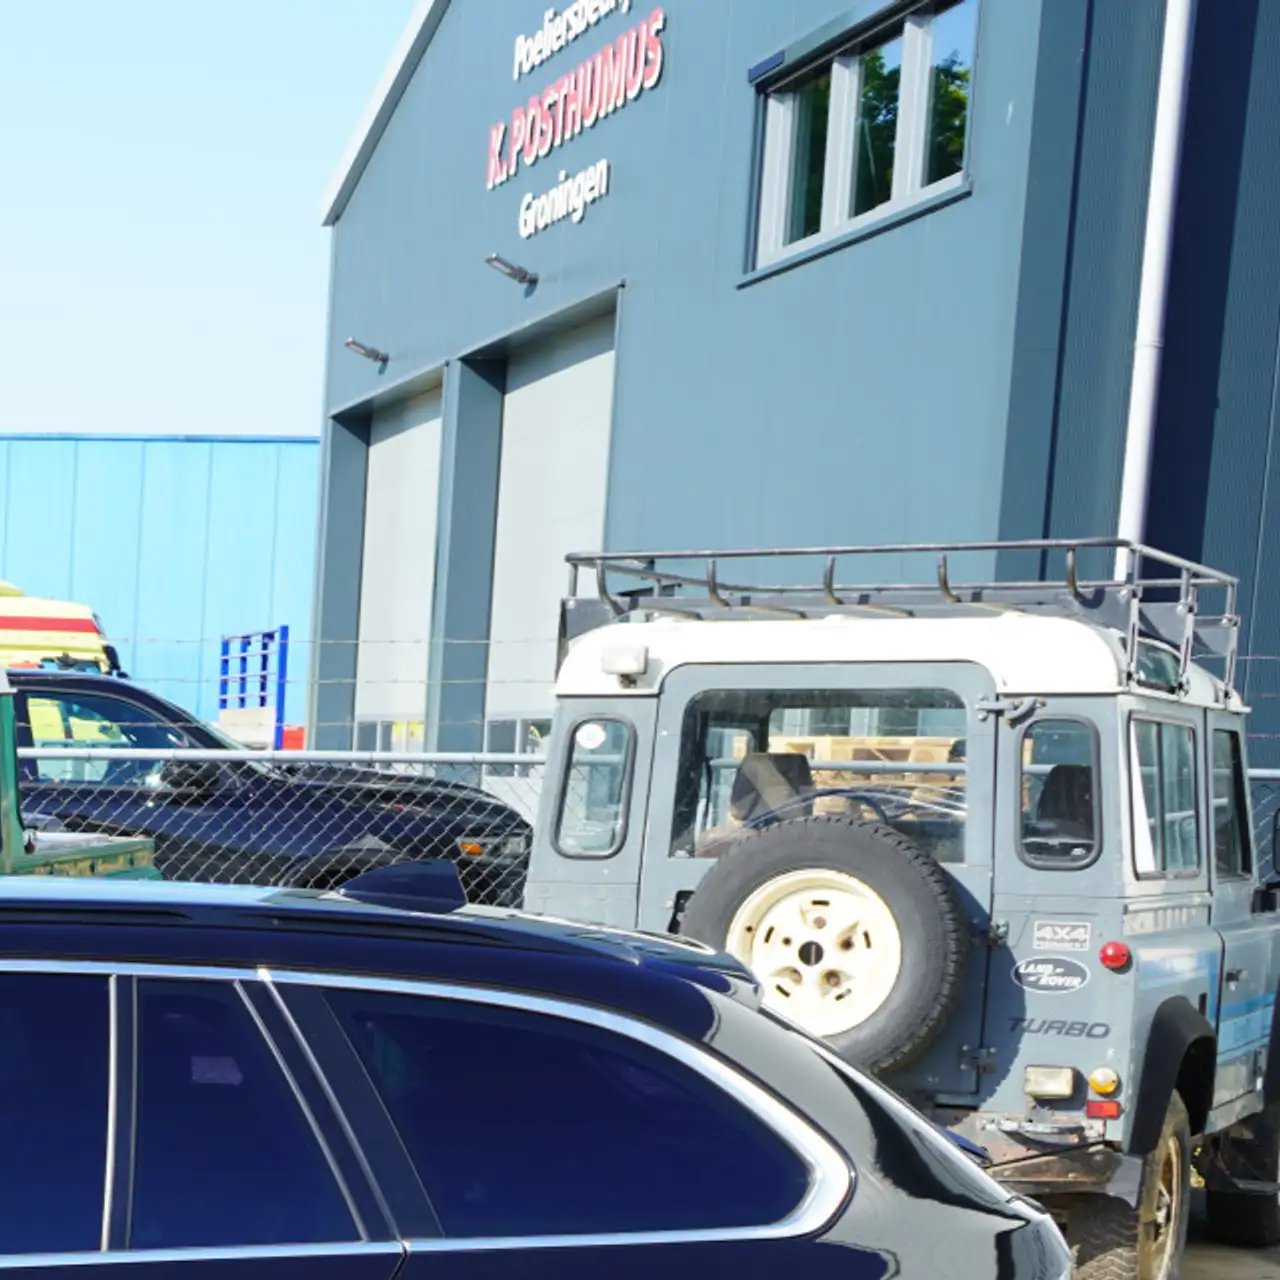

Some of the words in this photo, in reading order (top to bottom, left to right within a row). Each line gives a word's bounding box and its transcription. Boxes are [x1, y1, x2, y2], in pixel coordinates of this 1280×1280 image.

[509, 7, 664, 176] POSTHUMUS
[518, 158, 608, 239] Groningen
[1018, 963, 1054, 974] LAND
[1038, 975, 1083, 989] ROVER
[1008, 1016, 1111, 1039] TURBO
